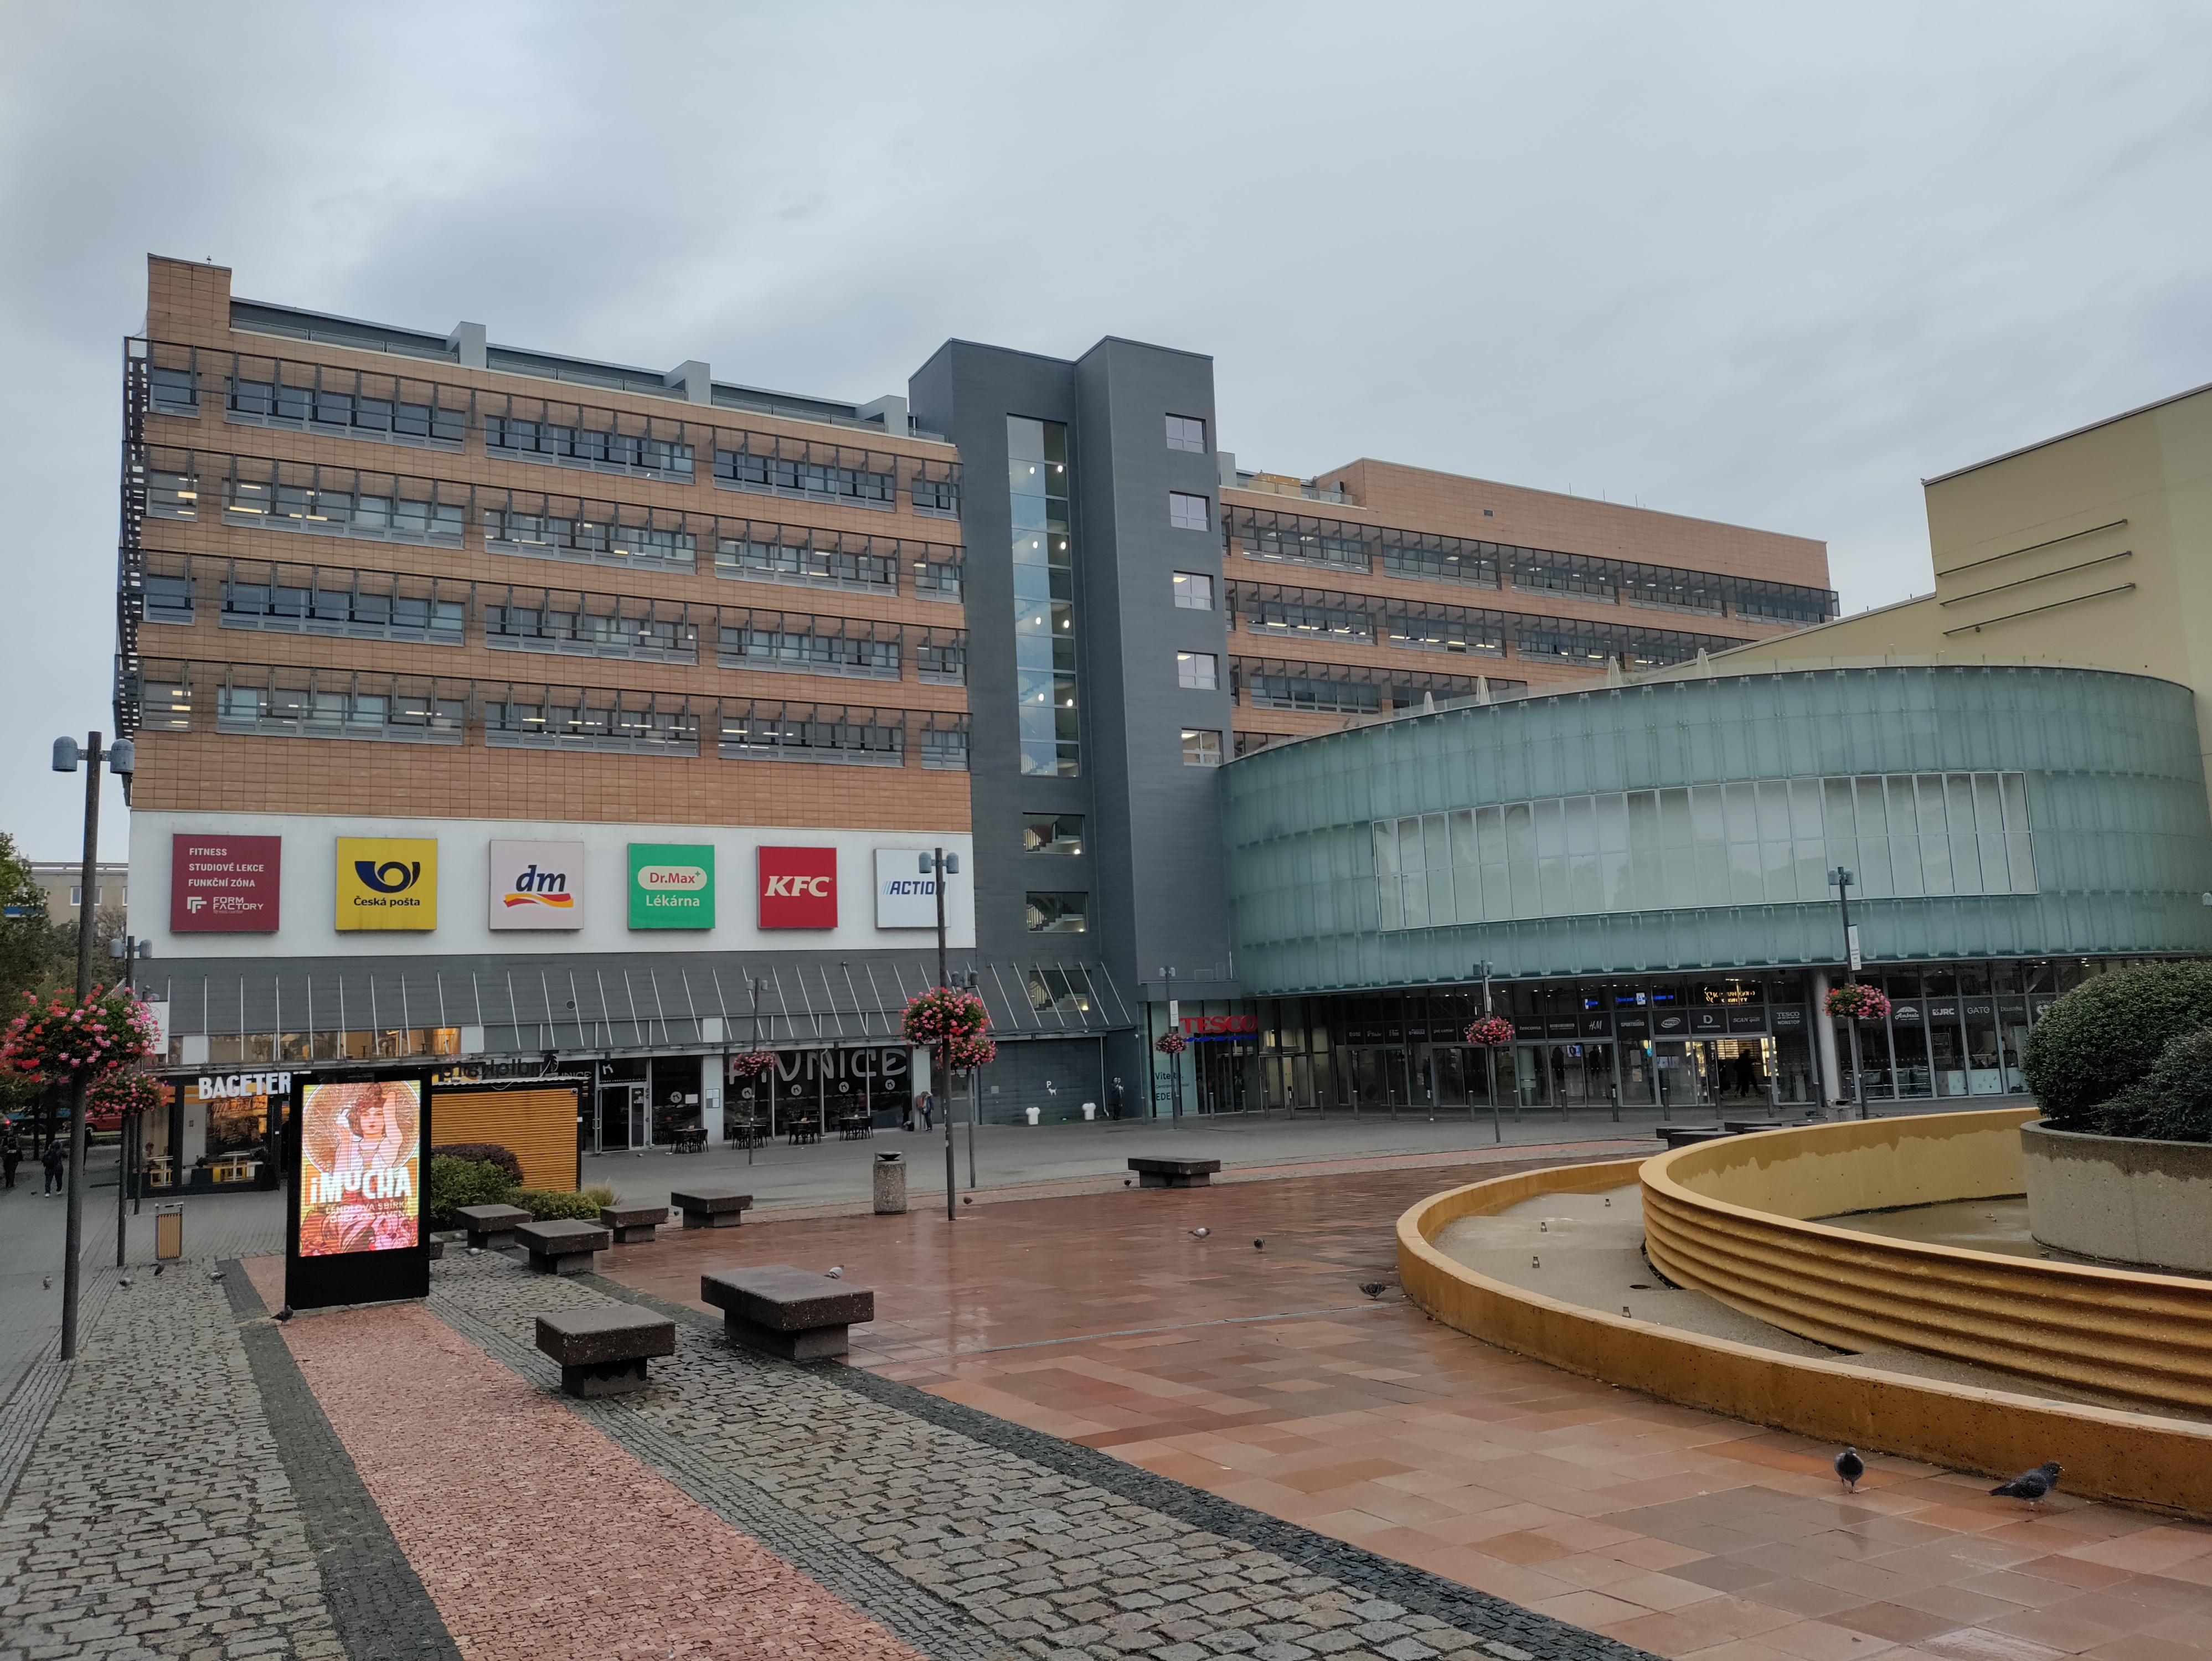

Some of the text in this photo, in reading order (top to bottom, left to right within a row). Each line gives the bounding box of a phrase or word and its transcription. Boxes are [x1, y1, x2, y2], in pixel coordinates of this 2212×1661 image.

[189, 848, 228, 856] FITNESS
[188, 862, 265, 872] STUDIOVÉ LEKCE
[188, 877, 256, 887] FUNKČNÍ ZÓNA
[515, 864, 566, 892] dm
[649, 872, 695, 884] Dr.Max
[764, 875, 831, 897] KFC
[353, 895, 421, 908] Česká pošta
[646, 894, 700, 907] Lékárna
[1179, 1014, 1259, 1035] TESCO
[1588, 1019, 1603, 1030] H&M
[198, 1071, 311, 1100] BAGETER
[1046, 1080, 1052, 1089] P
[1156, 1092, 1177, 1101] EDE
